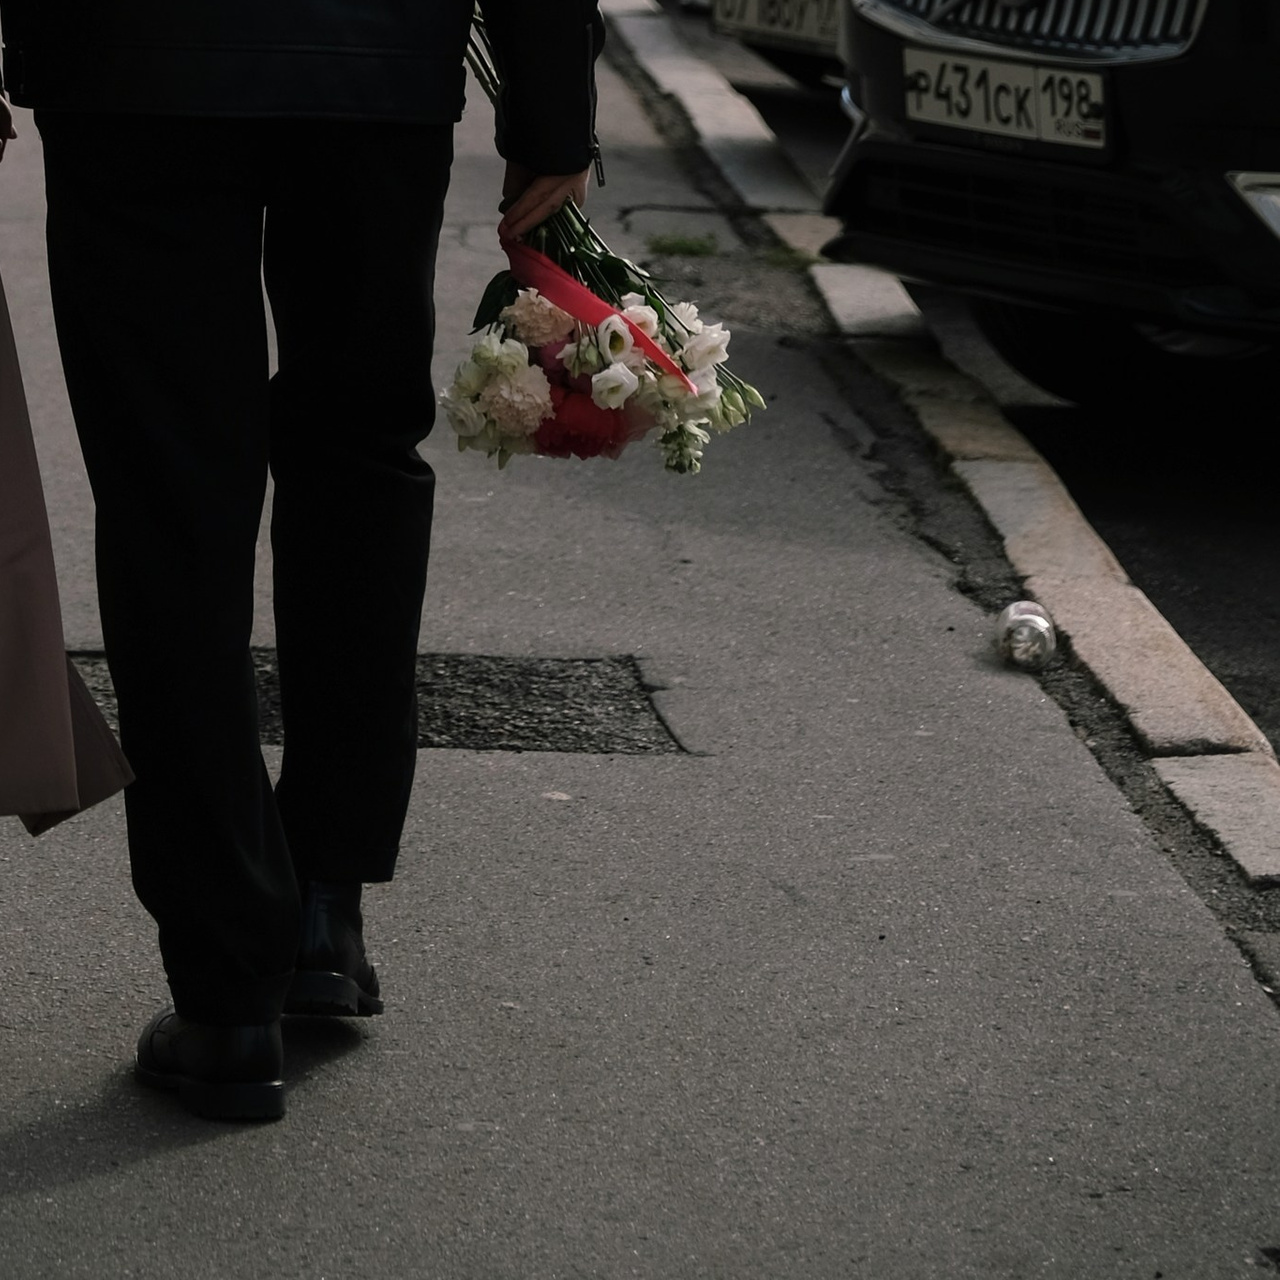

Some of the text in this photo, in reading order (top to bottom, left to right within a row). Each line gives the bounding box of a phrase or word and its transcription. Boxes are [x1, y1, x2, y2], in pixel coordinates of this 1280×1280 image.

[914, 61, 1092, 130] Р431СК 198
[1055, 118, 1083, 138] RUS
